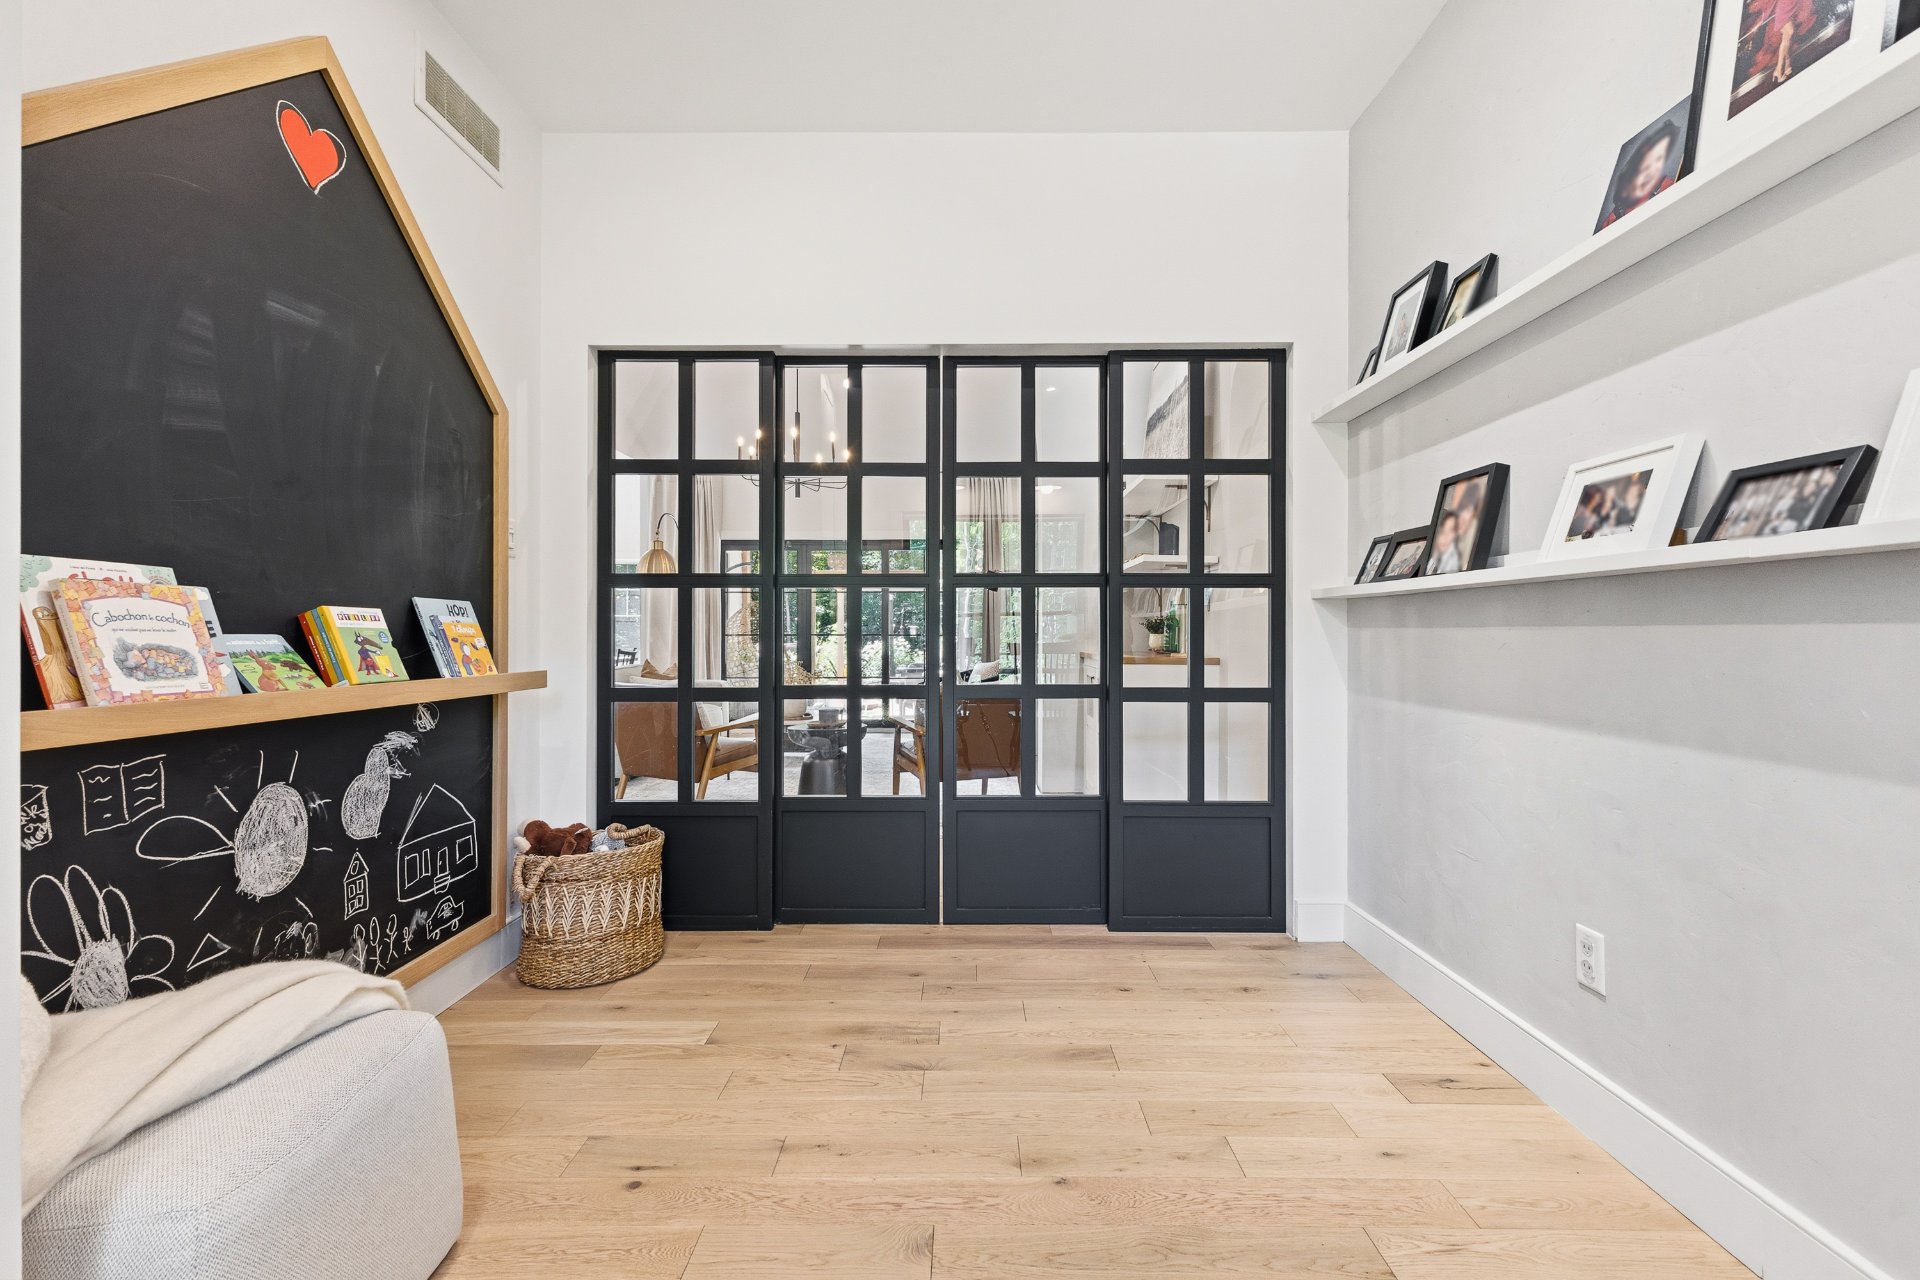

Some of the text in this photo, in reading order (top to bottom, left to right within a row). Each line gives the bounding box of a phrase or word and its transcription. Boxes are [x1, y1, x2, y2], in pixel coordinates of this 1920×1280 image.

[92, 609, 147, 627] Cabochon
[155, 613, 190, 628] cochon
[446, 604, 470, 618] HOP!
